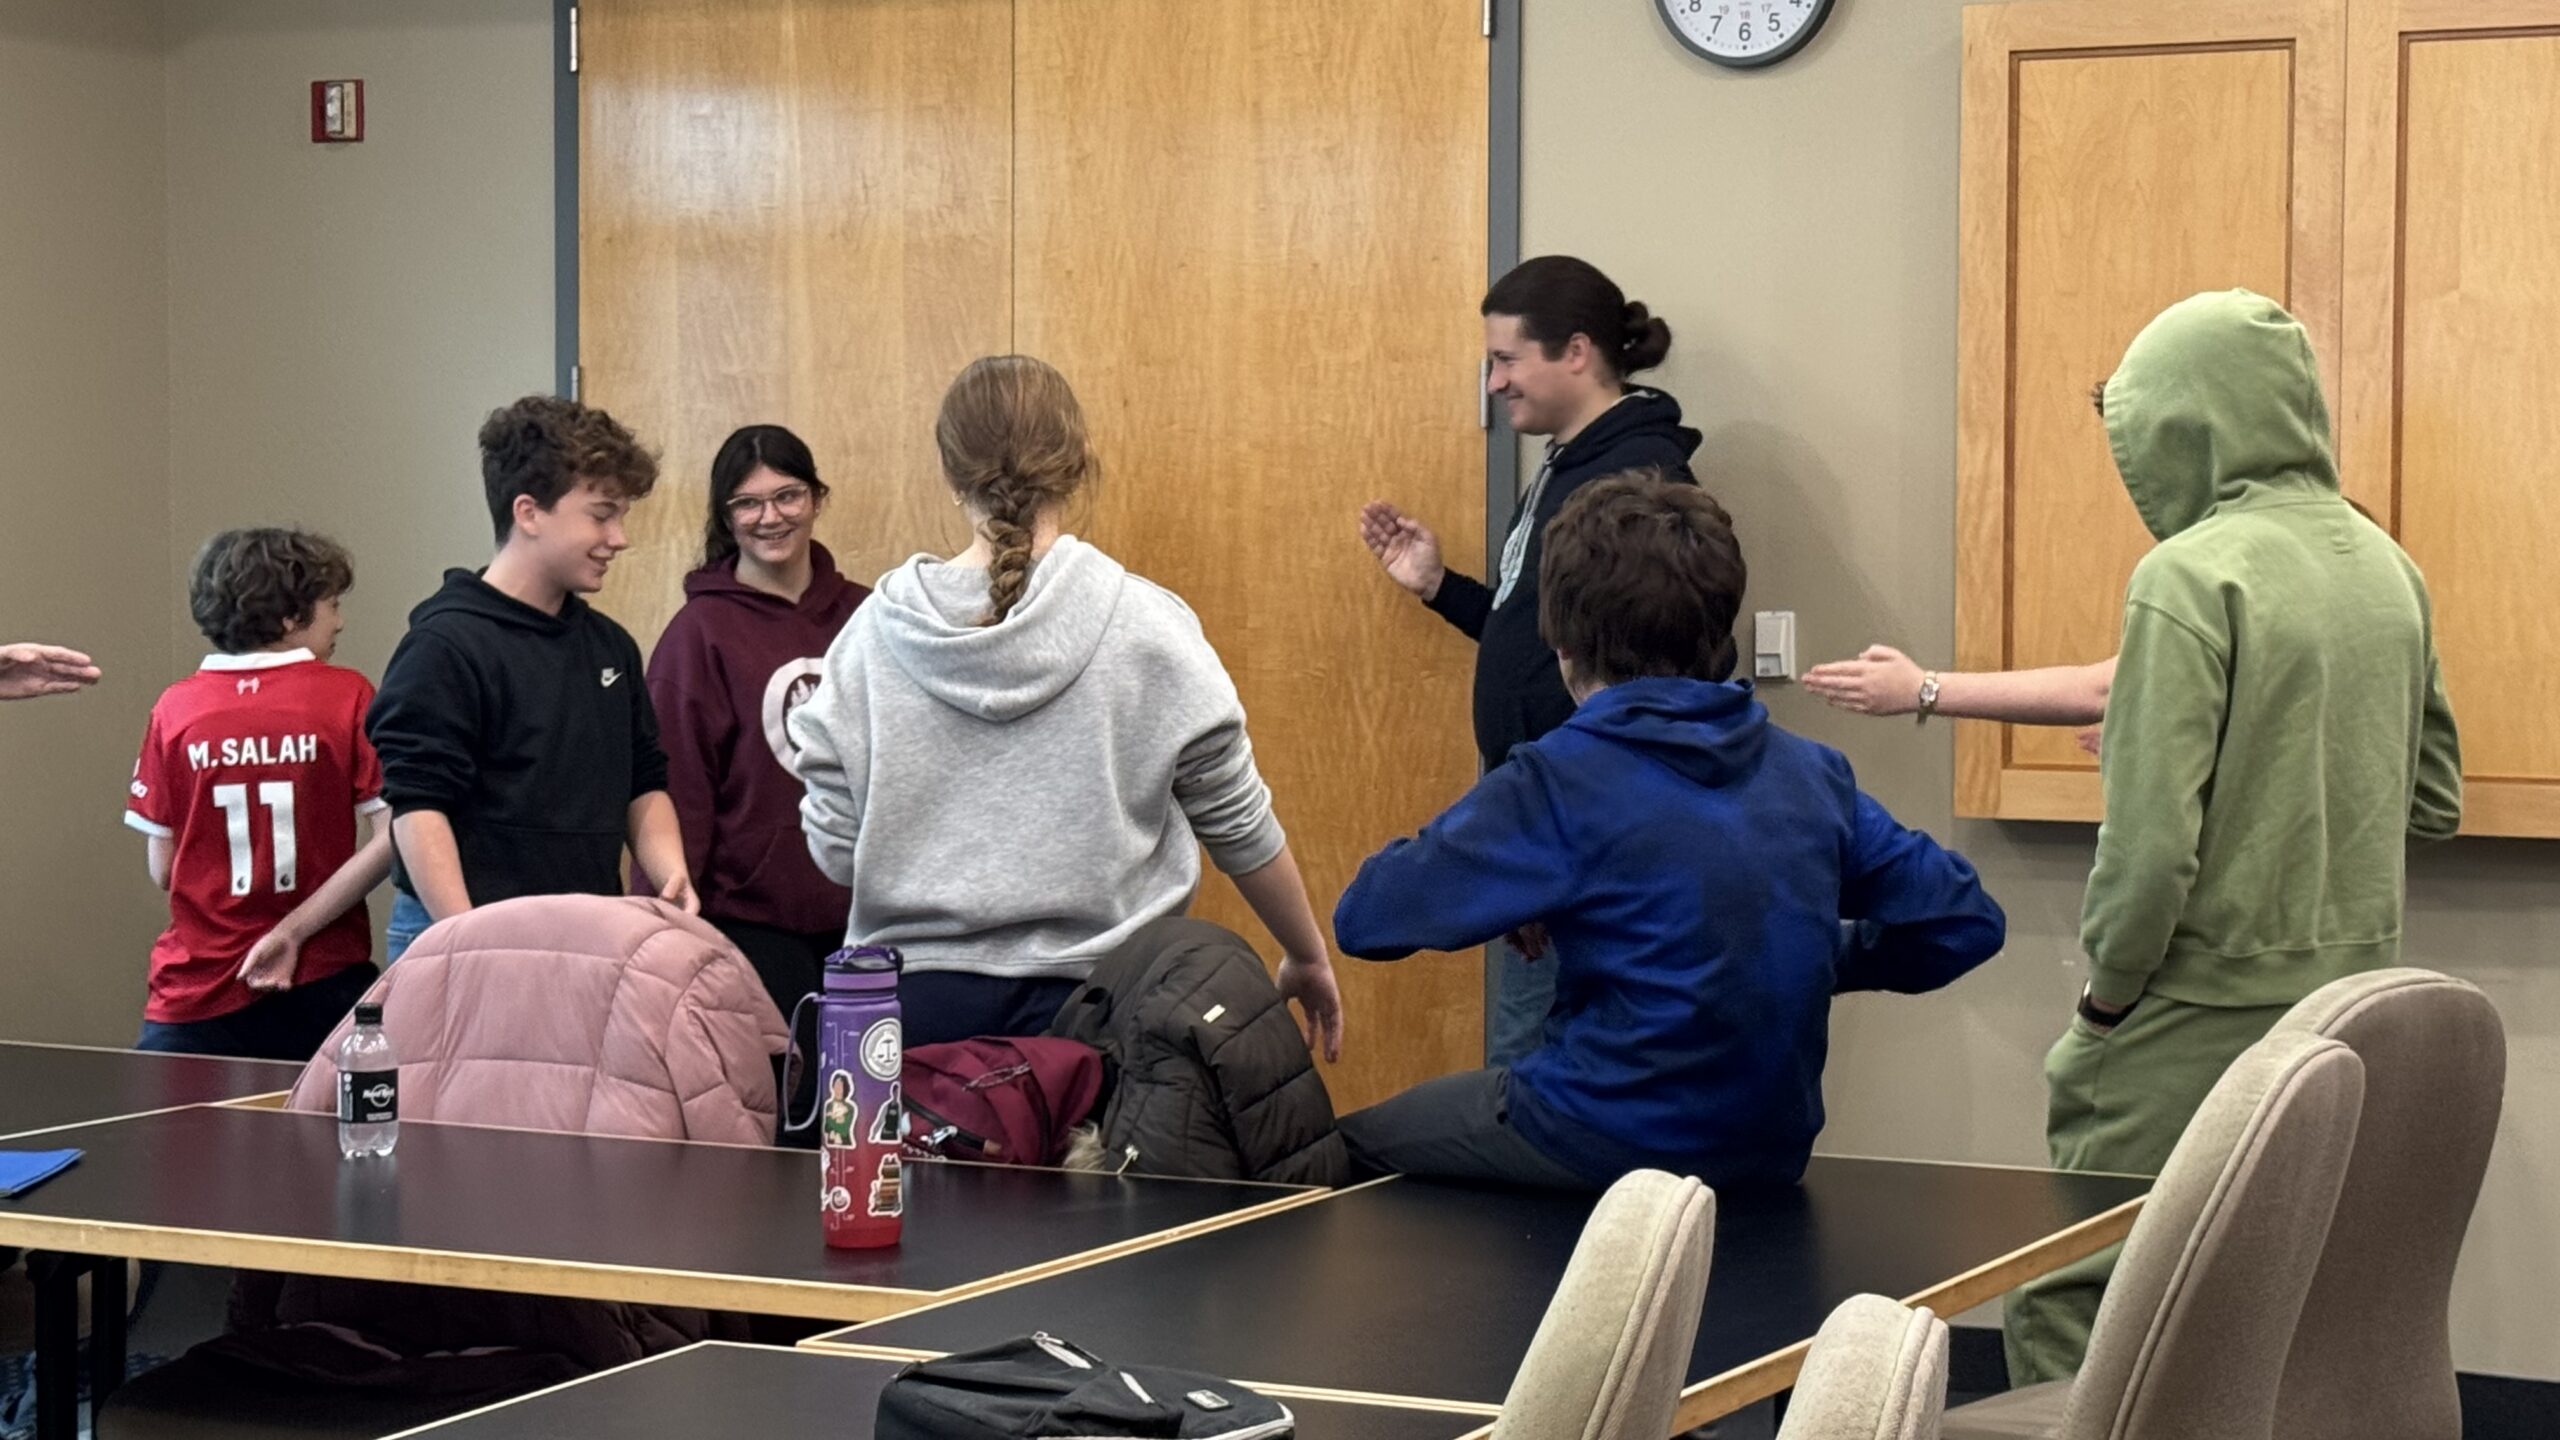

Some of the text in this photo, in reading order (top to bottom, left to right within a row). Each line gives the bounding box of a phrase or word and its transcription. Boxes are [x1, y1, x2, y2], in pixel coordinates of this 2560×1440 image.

[1710, 15, 1723, 35] 7
[1738, 22, 1752, 42] 6
[1768, 12, 1781, 32] 5
[212, 780, 300, 896] 11
